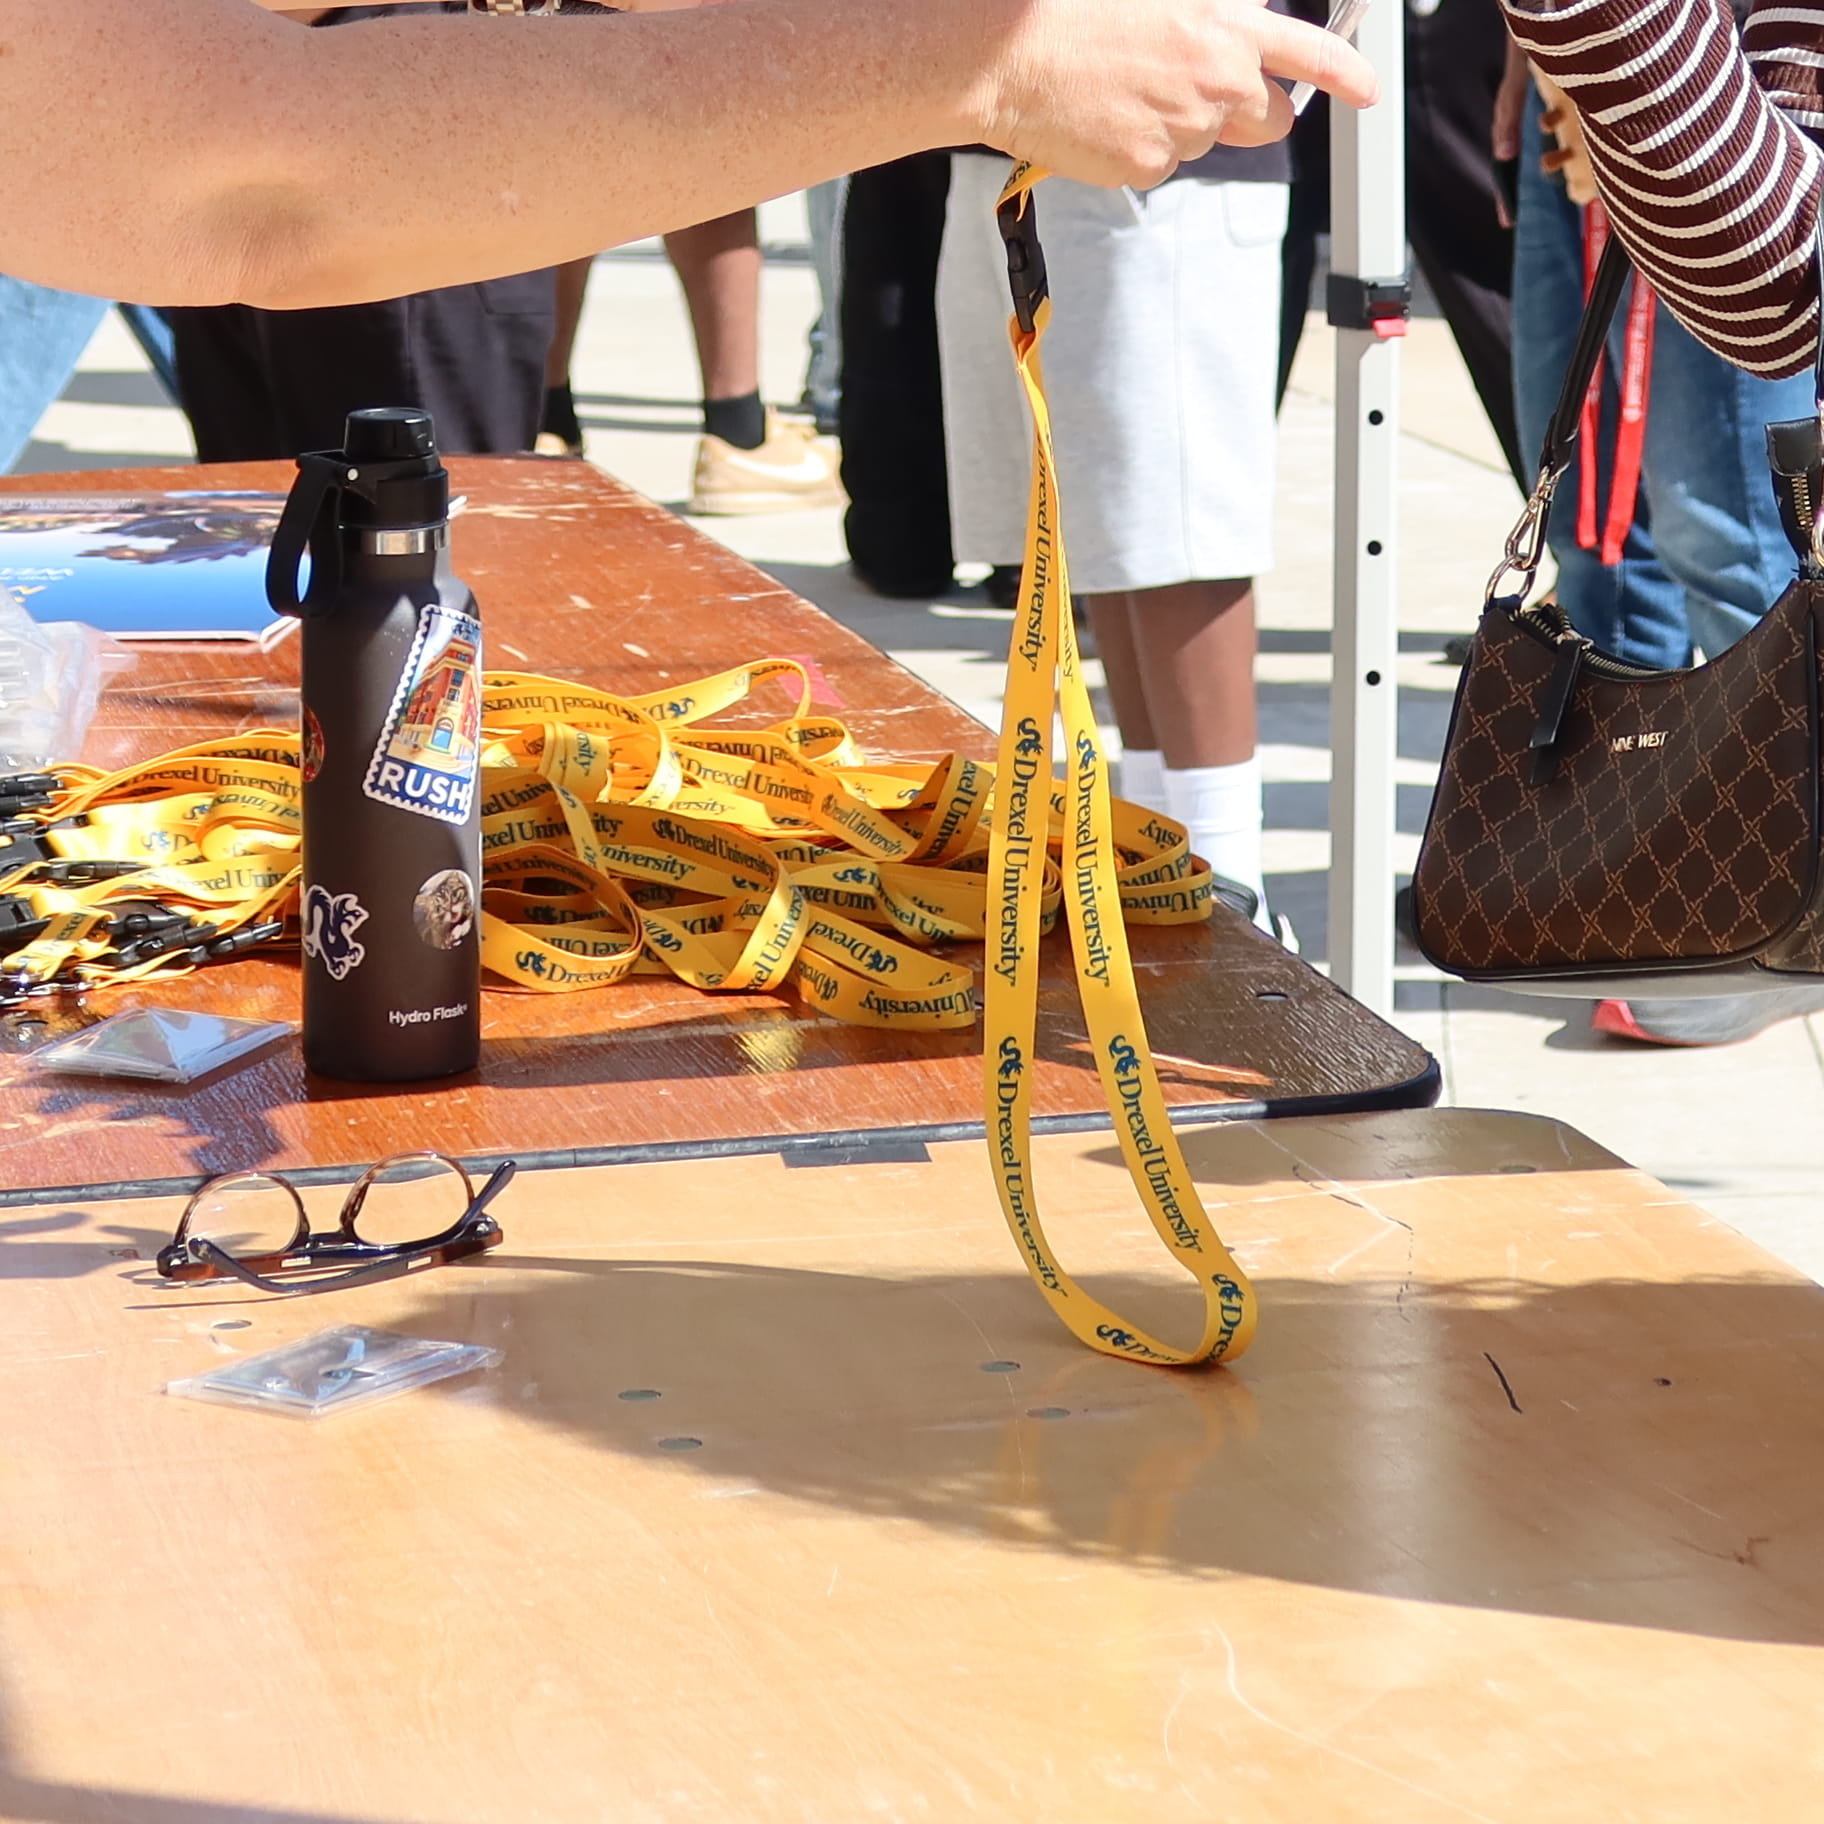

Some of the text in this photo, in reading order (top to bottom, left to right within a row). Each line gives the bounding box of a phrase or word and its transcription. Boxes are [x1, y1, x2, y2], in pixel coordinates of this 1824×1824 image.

[1020, 534, 1052, 672] University
[1638, 731, 1669, 749] WEST
[201, 766, 302, 803] University
[378, 761, 469, 811] RUSH
[687, 758, 751, 789] Drexel
[676, 826, 718, 857] Drexel
[851, 809, 906, 856] University
[601, 845, 695, 880] niversity
[994, 756, 1038, 987] Drexel University
[1076, 771, 1112, 987] Drexel University
[806, 922, 871, 962] Drexel
[546, 963, 618, 984] Drexel
[389, 1010, 431, 1027] Hydro
[859, 991, 969, 1018] University
[1117, 1075, 1204, 1254] Drexel University
[997, 1079, 1069, 1298] Drexel University
[1209, 1304, 1242, 1360] Dre
